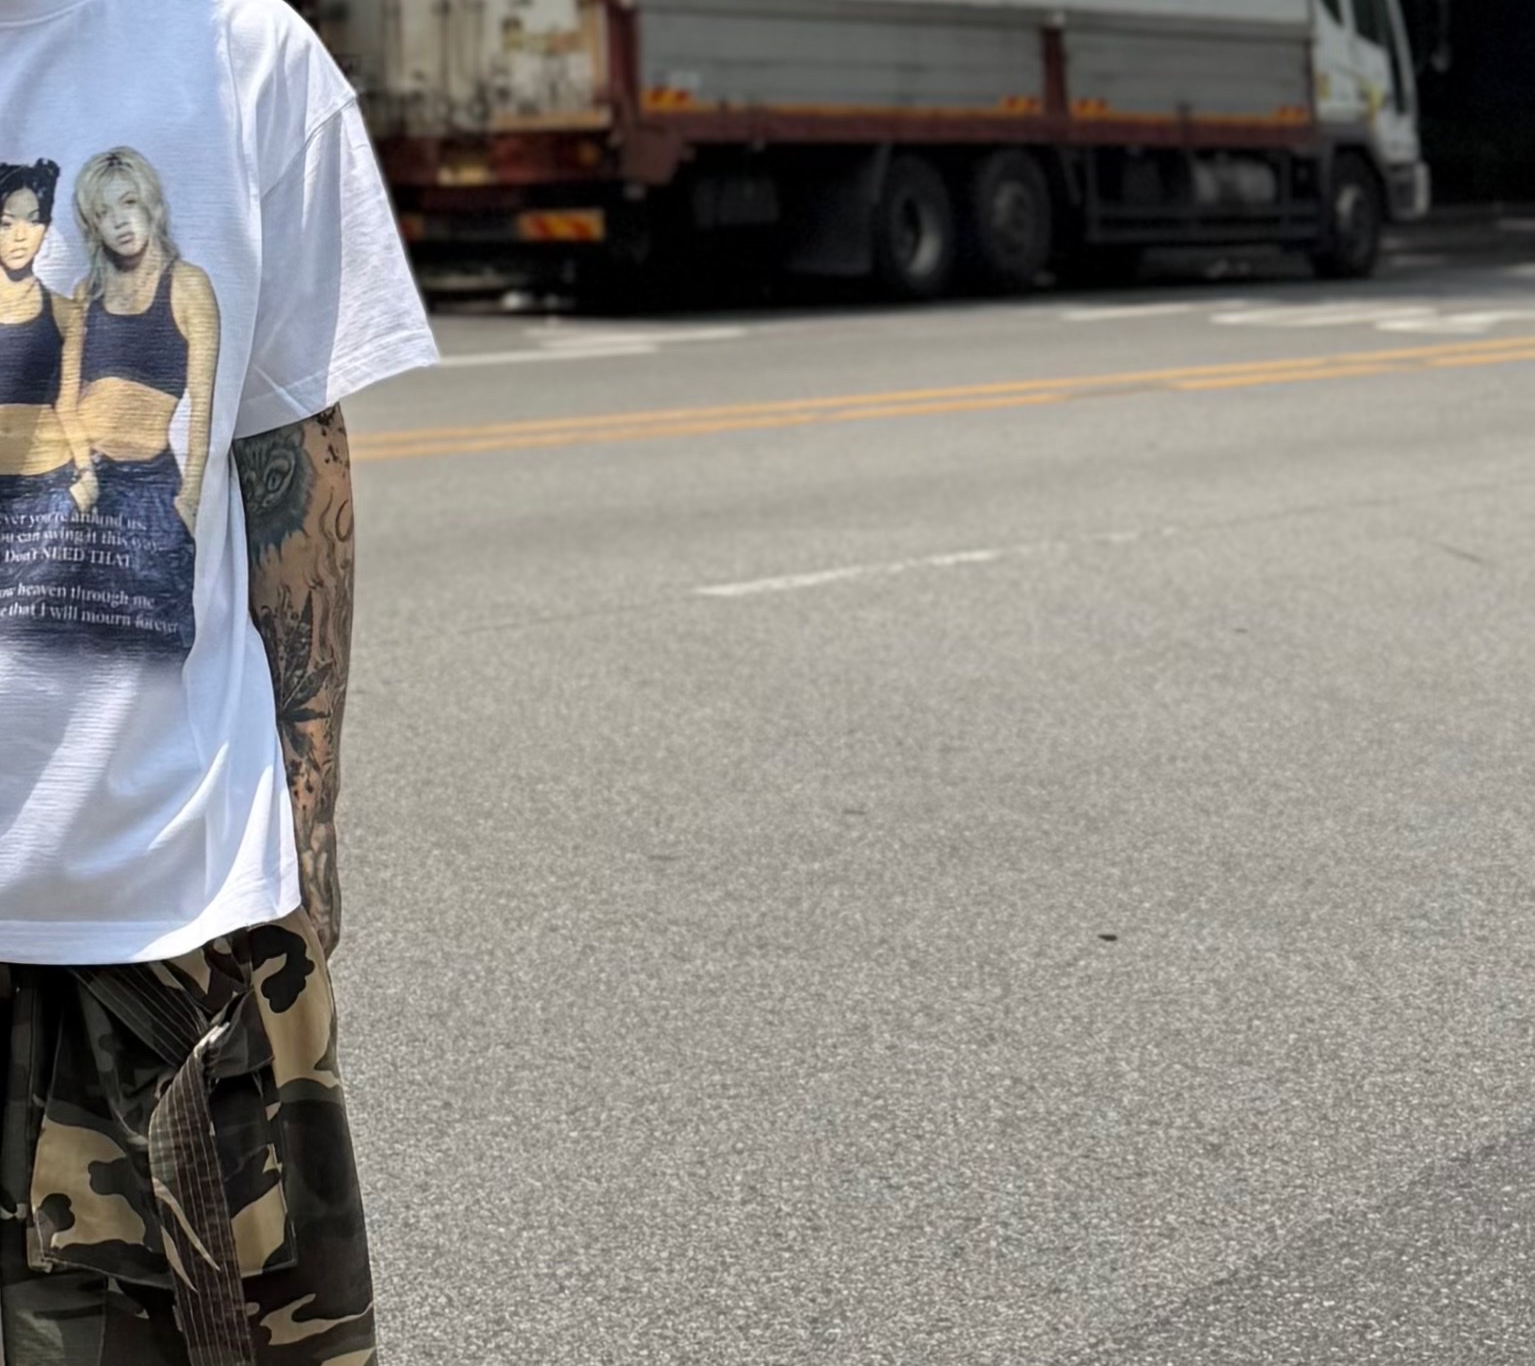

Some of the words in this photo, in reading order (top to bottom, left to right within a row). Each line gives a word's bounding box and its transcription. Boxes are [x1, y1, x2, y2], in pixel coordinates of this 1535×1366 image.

[17, 532, 41, 544] can
[101, 530, 128, 547] this
[43, 546, 85, 563] NEED
[18, 582, 67, 598] heaven
[71, 585, 129, 609] through
[132, 595, 156, 610] me
[8, 601, 36, 617] that
[49, 605, 79, 621] will
[81, 610, 131, 628] mourn
